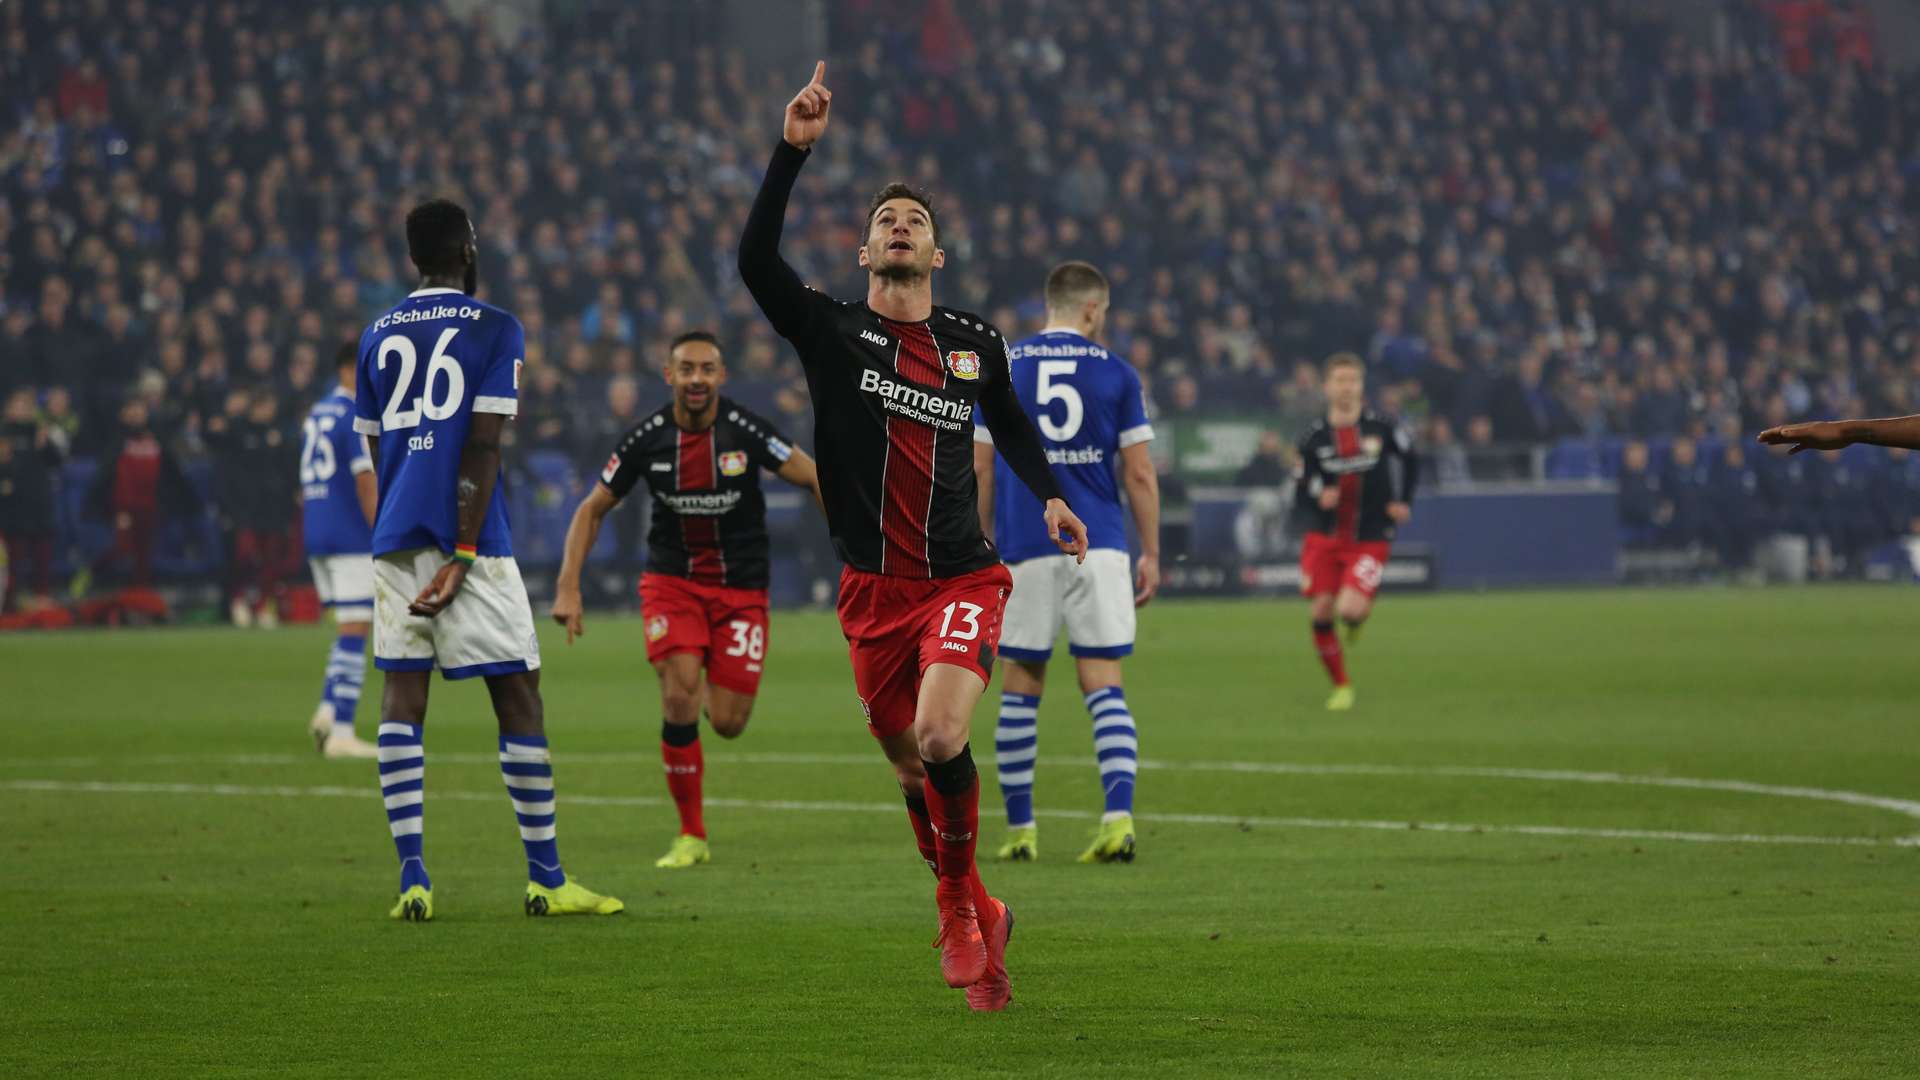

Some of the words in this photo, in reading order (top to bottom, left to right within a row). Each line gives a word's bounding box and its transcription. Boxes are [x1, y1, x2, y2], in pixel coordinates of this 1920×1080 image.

[373, 315, 392, 333] FC
[392, 306, 457, 325] Schalke
[459, 306, 481, 320] 04
[860, 330, 888, 346] JAKO
[1023, 344, 1087, 357] Schalke
[378, 328, 464, 432] 26
[860, 369, 972, 421] Barmenia
[883, 398, 961, 431] Versicherungen
[1036, 360, 1084, 442] 5
[300, 416, 337, 484] 25
[1043, 445, 1103, 465] atasic
[939, 601, 984, 641] 13
[726, 620, 763, 661] 38
[940, 641, 969, 653] JAKO
